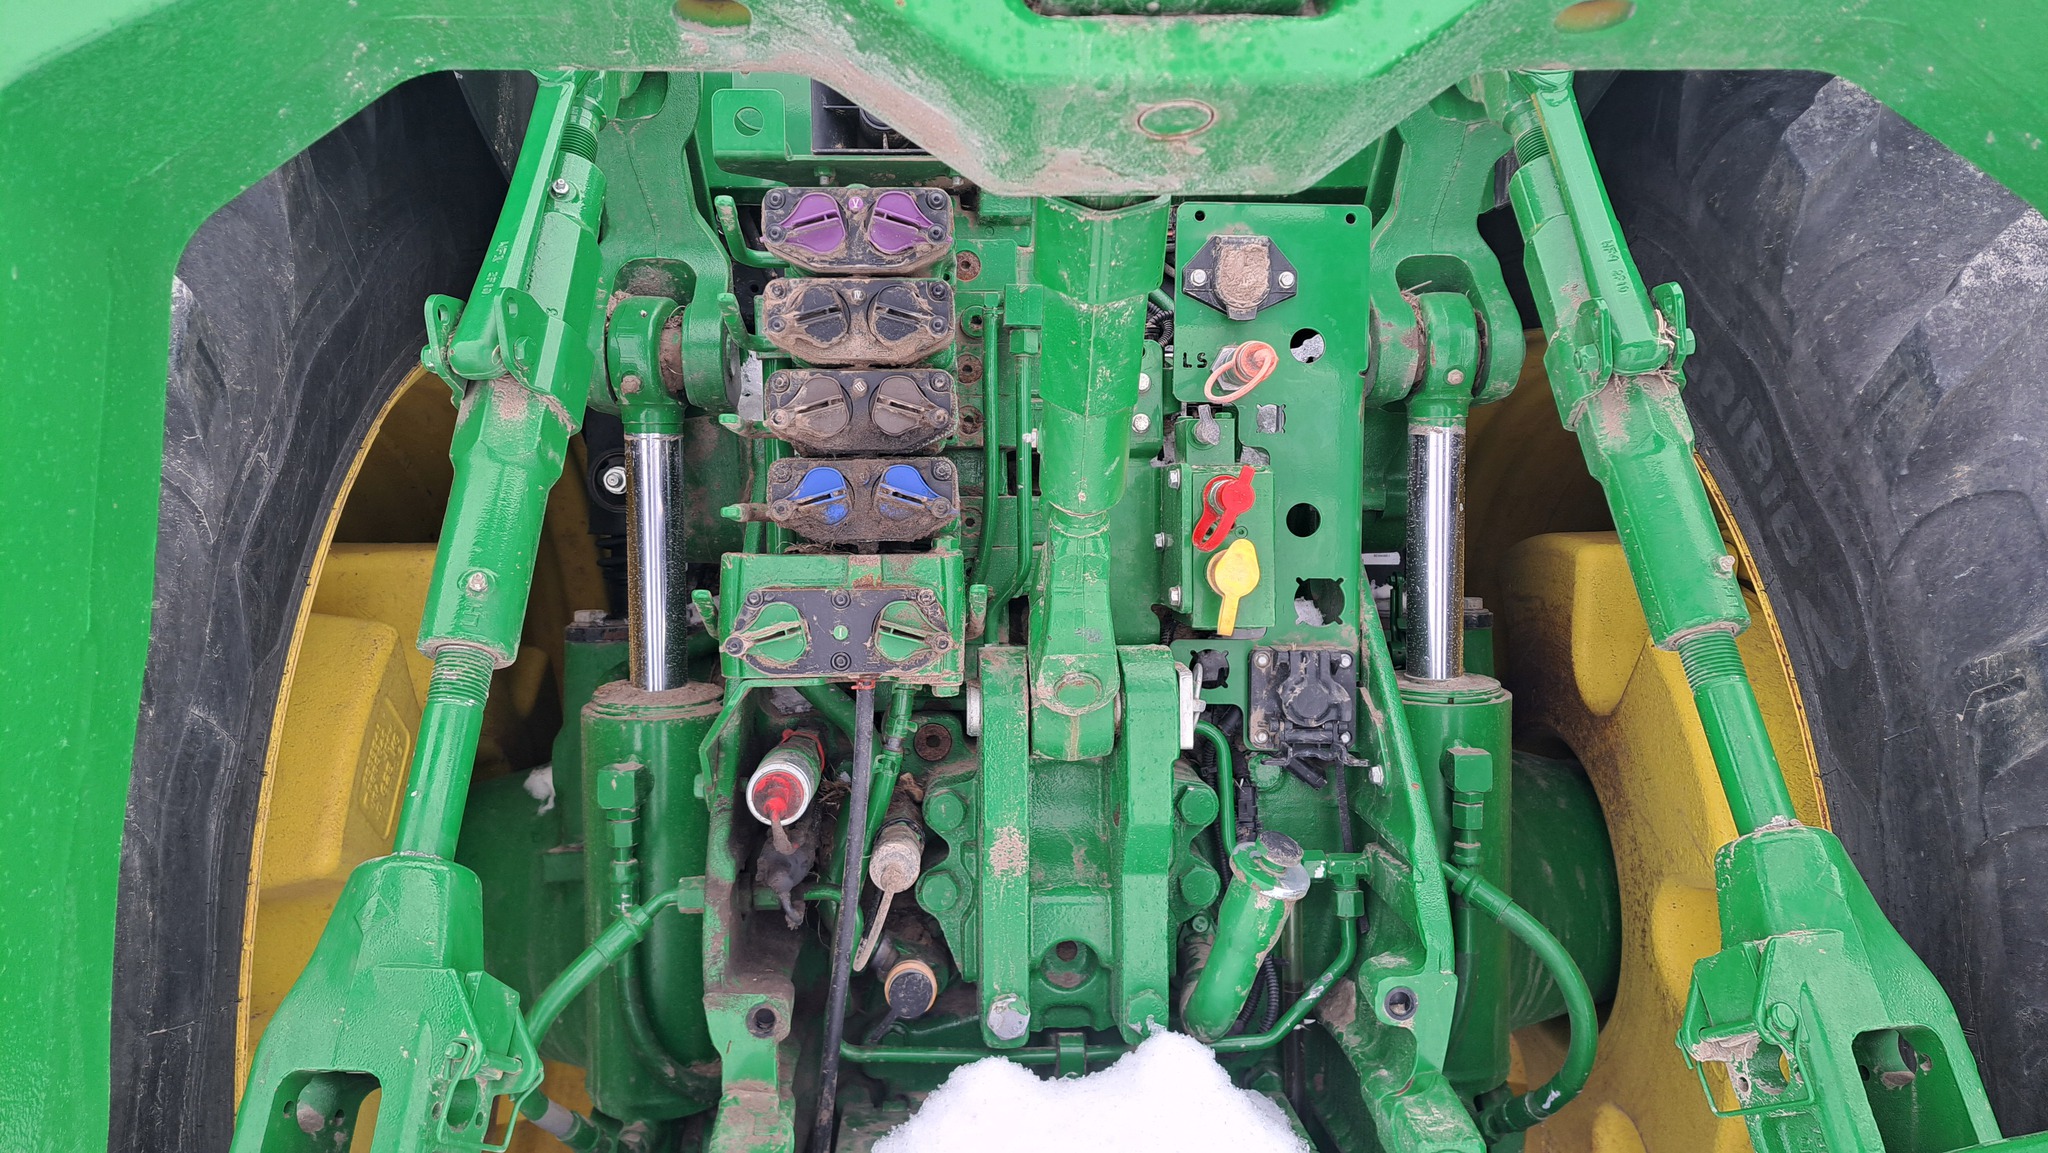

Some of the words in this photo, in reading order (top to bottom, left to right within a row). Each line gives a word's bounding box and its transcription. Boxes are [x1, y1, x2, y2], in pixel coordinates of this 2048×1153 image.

[852, 198, 860, 210] V
[1183, 351, 1209, 369] LS
[1686, 357, 1811, 568] RIBIB
